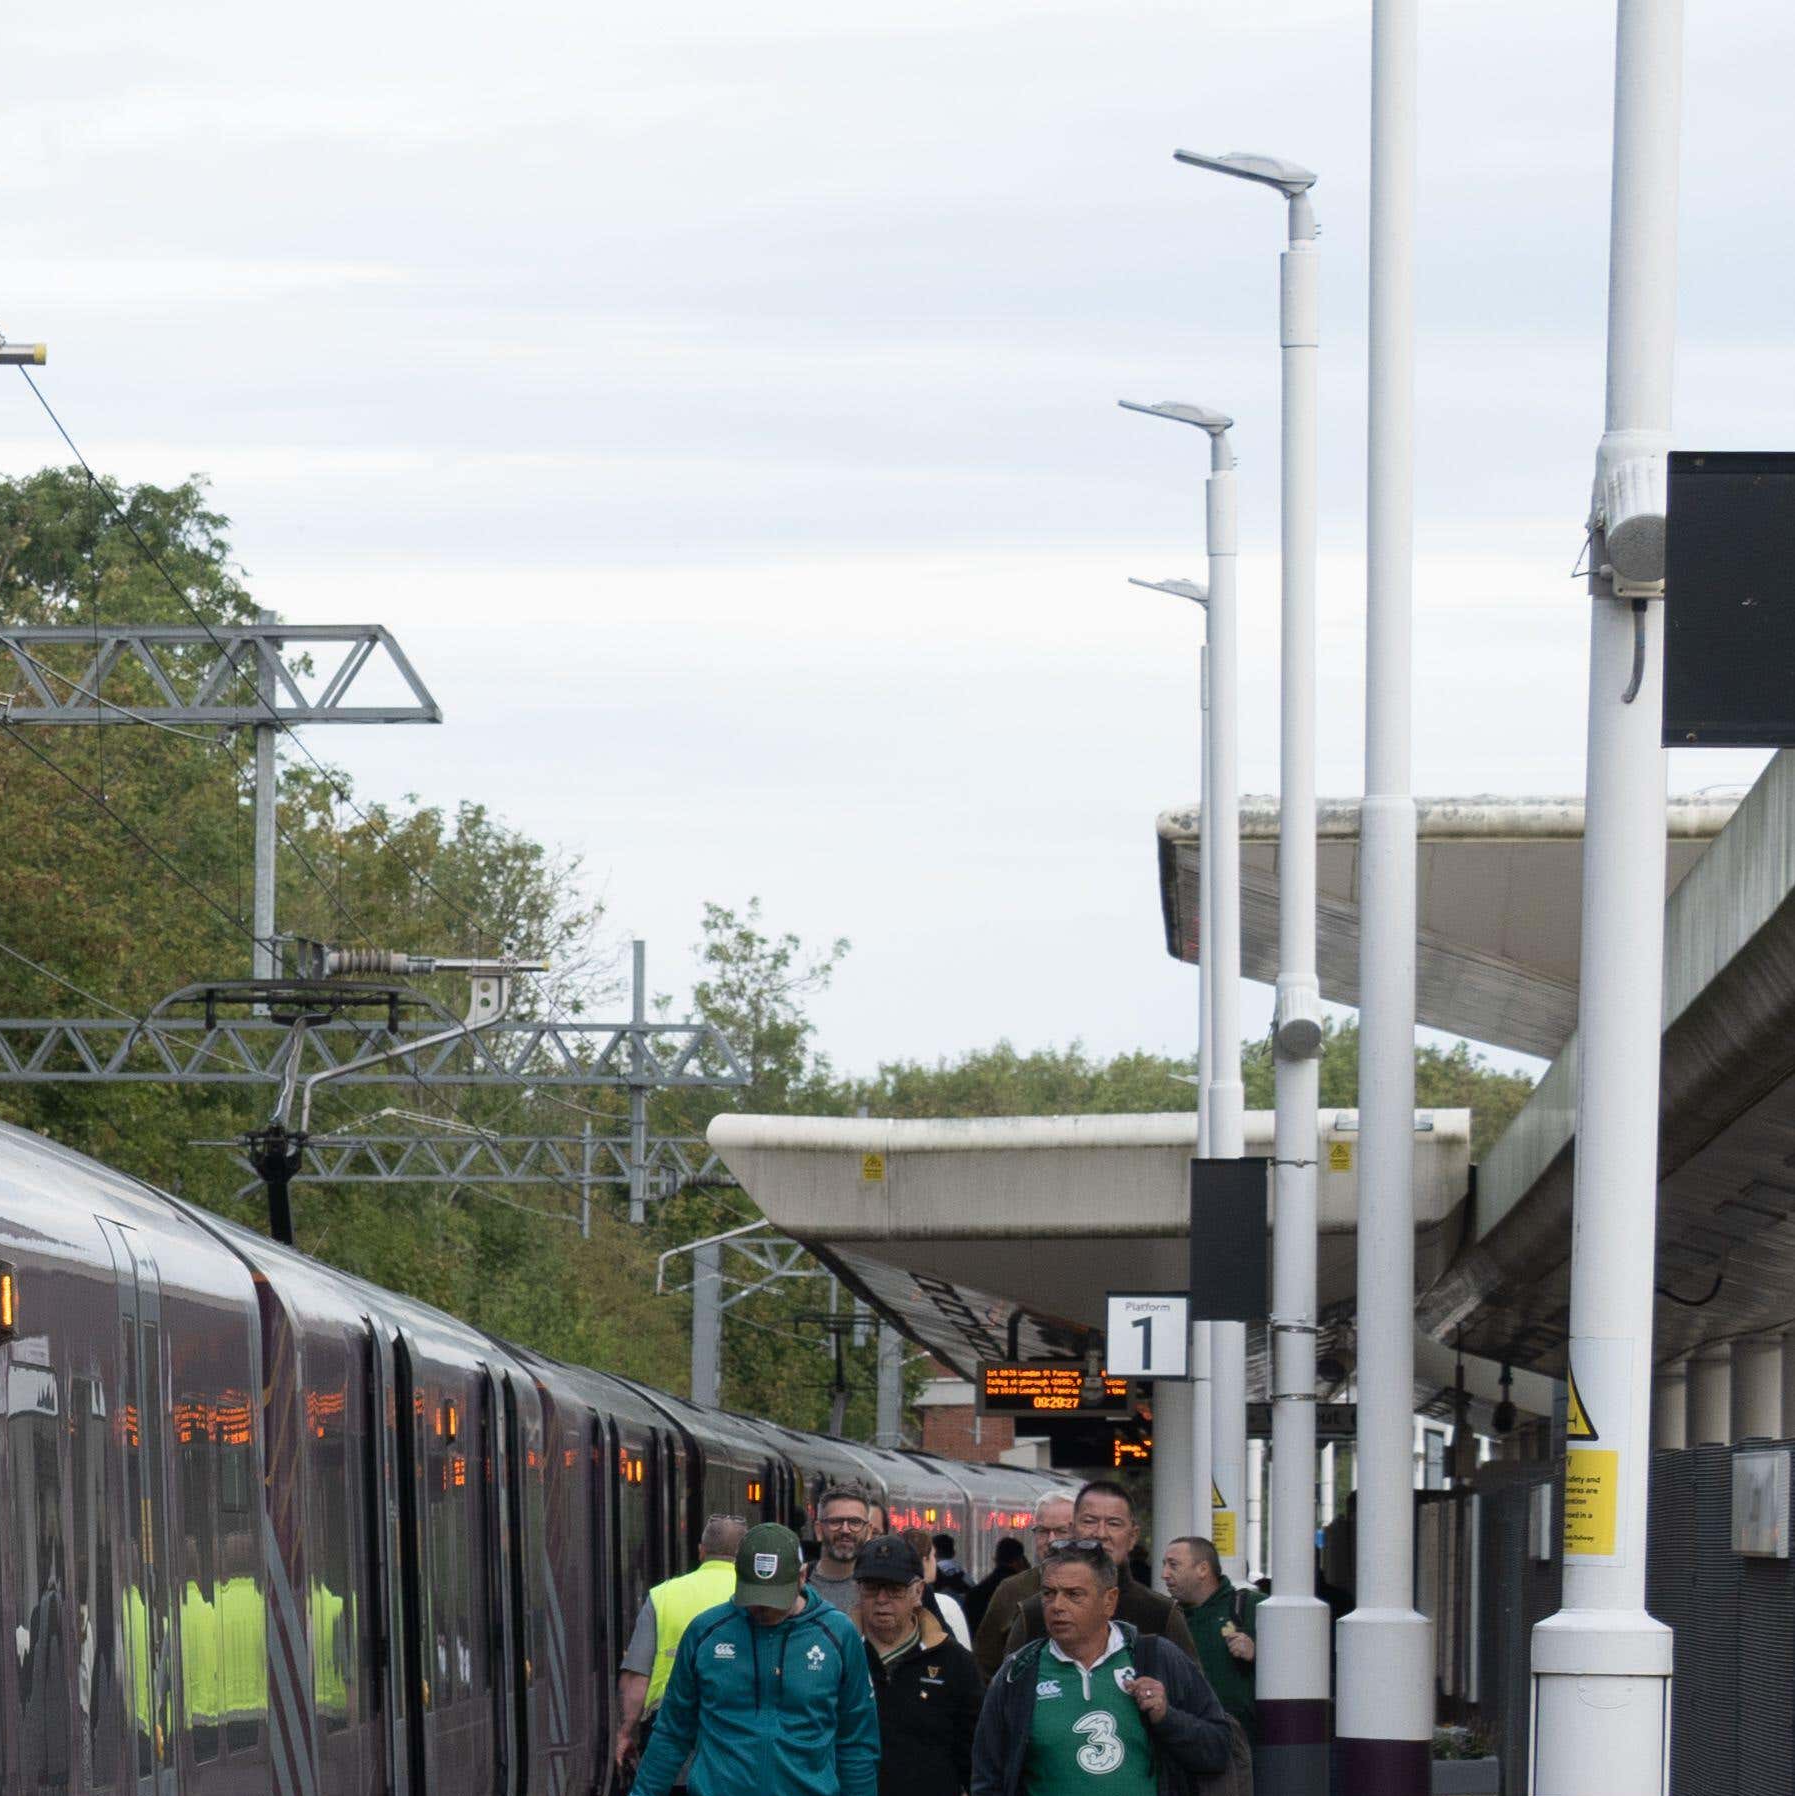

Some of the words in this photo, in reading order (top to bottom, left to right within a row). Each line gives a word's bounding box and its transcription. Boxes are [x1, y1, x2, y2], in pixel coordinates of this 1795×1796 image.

[1125, 1301, 1171, 1312] Platform
[1131, 1315, 1152, 1371] 1
[1072, 1710, 1125, 1775] 3
